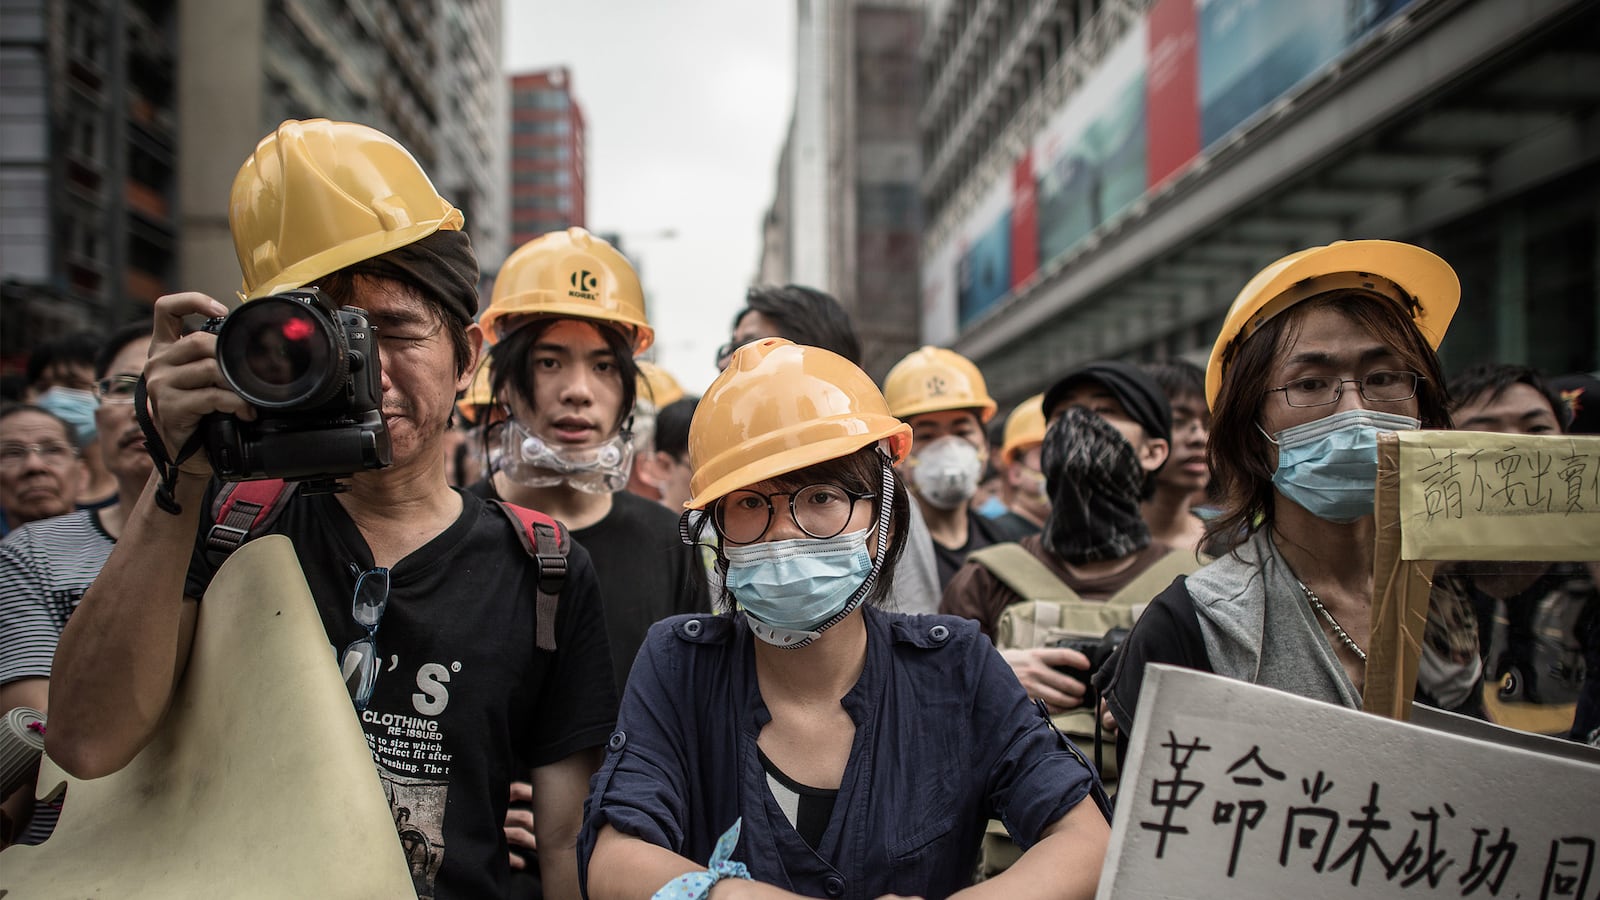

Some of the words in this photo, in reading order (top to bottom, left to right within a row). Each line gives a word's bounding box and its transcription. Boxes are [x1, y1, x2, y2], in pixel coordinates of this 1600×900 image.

[568, 290, 596, 301] KOREL
[362, 710, 439, 731] CLOTHING
[387, 726, 443, 741] RE-ISSUED
[378, 737, 387, 745] to
[390, 739, 409, 749] size
[413, 741, 442, 751] which
[378, 745, 410, 758] perfect
[413, 749, 425, 760] fit
[428, 751, 453, 761] after
[382, 757, 420, 773] washing.
[424, 763, 443, 774] The
